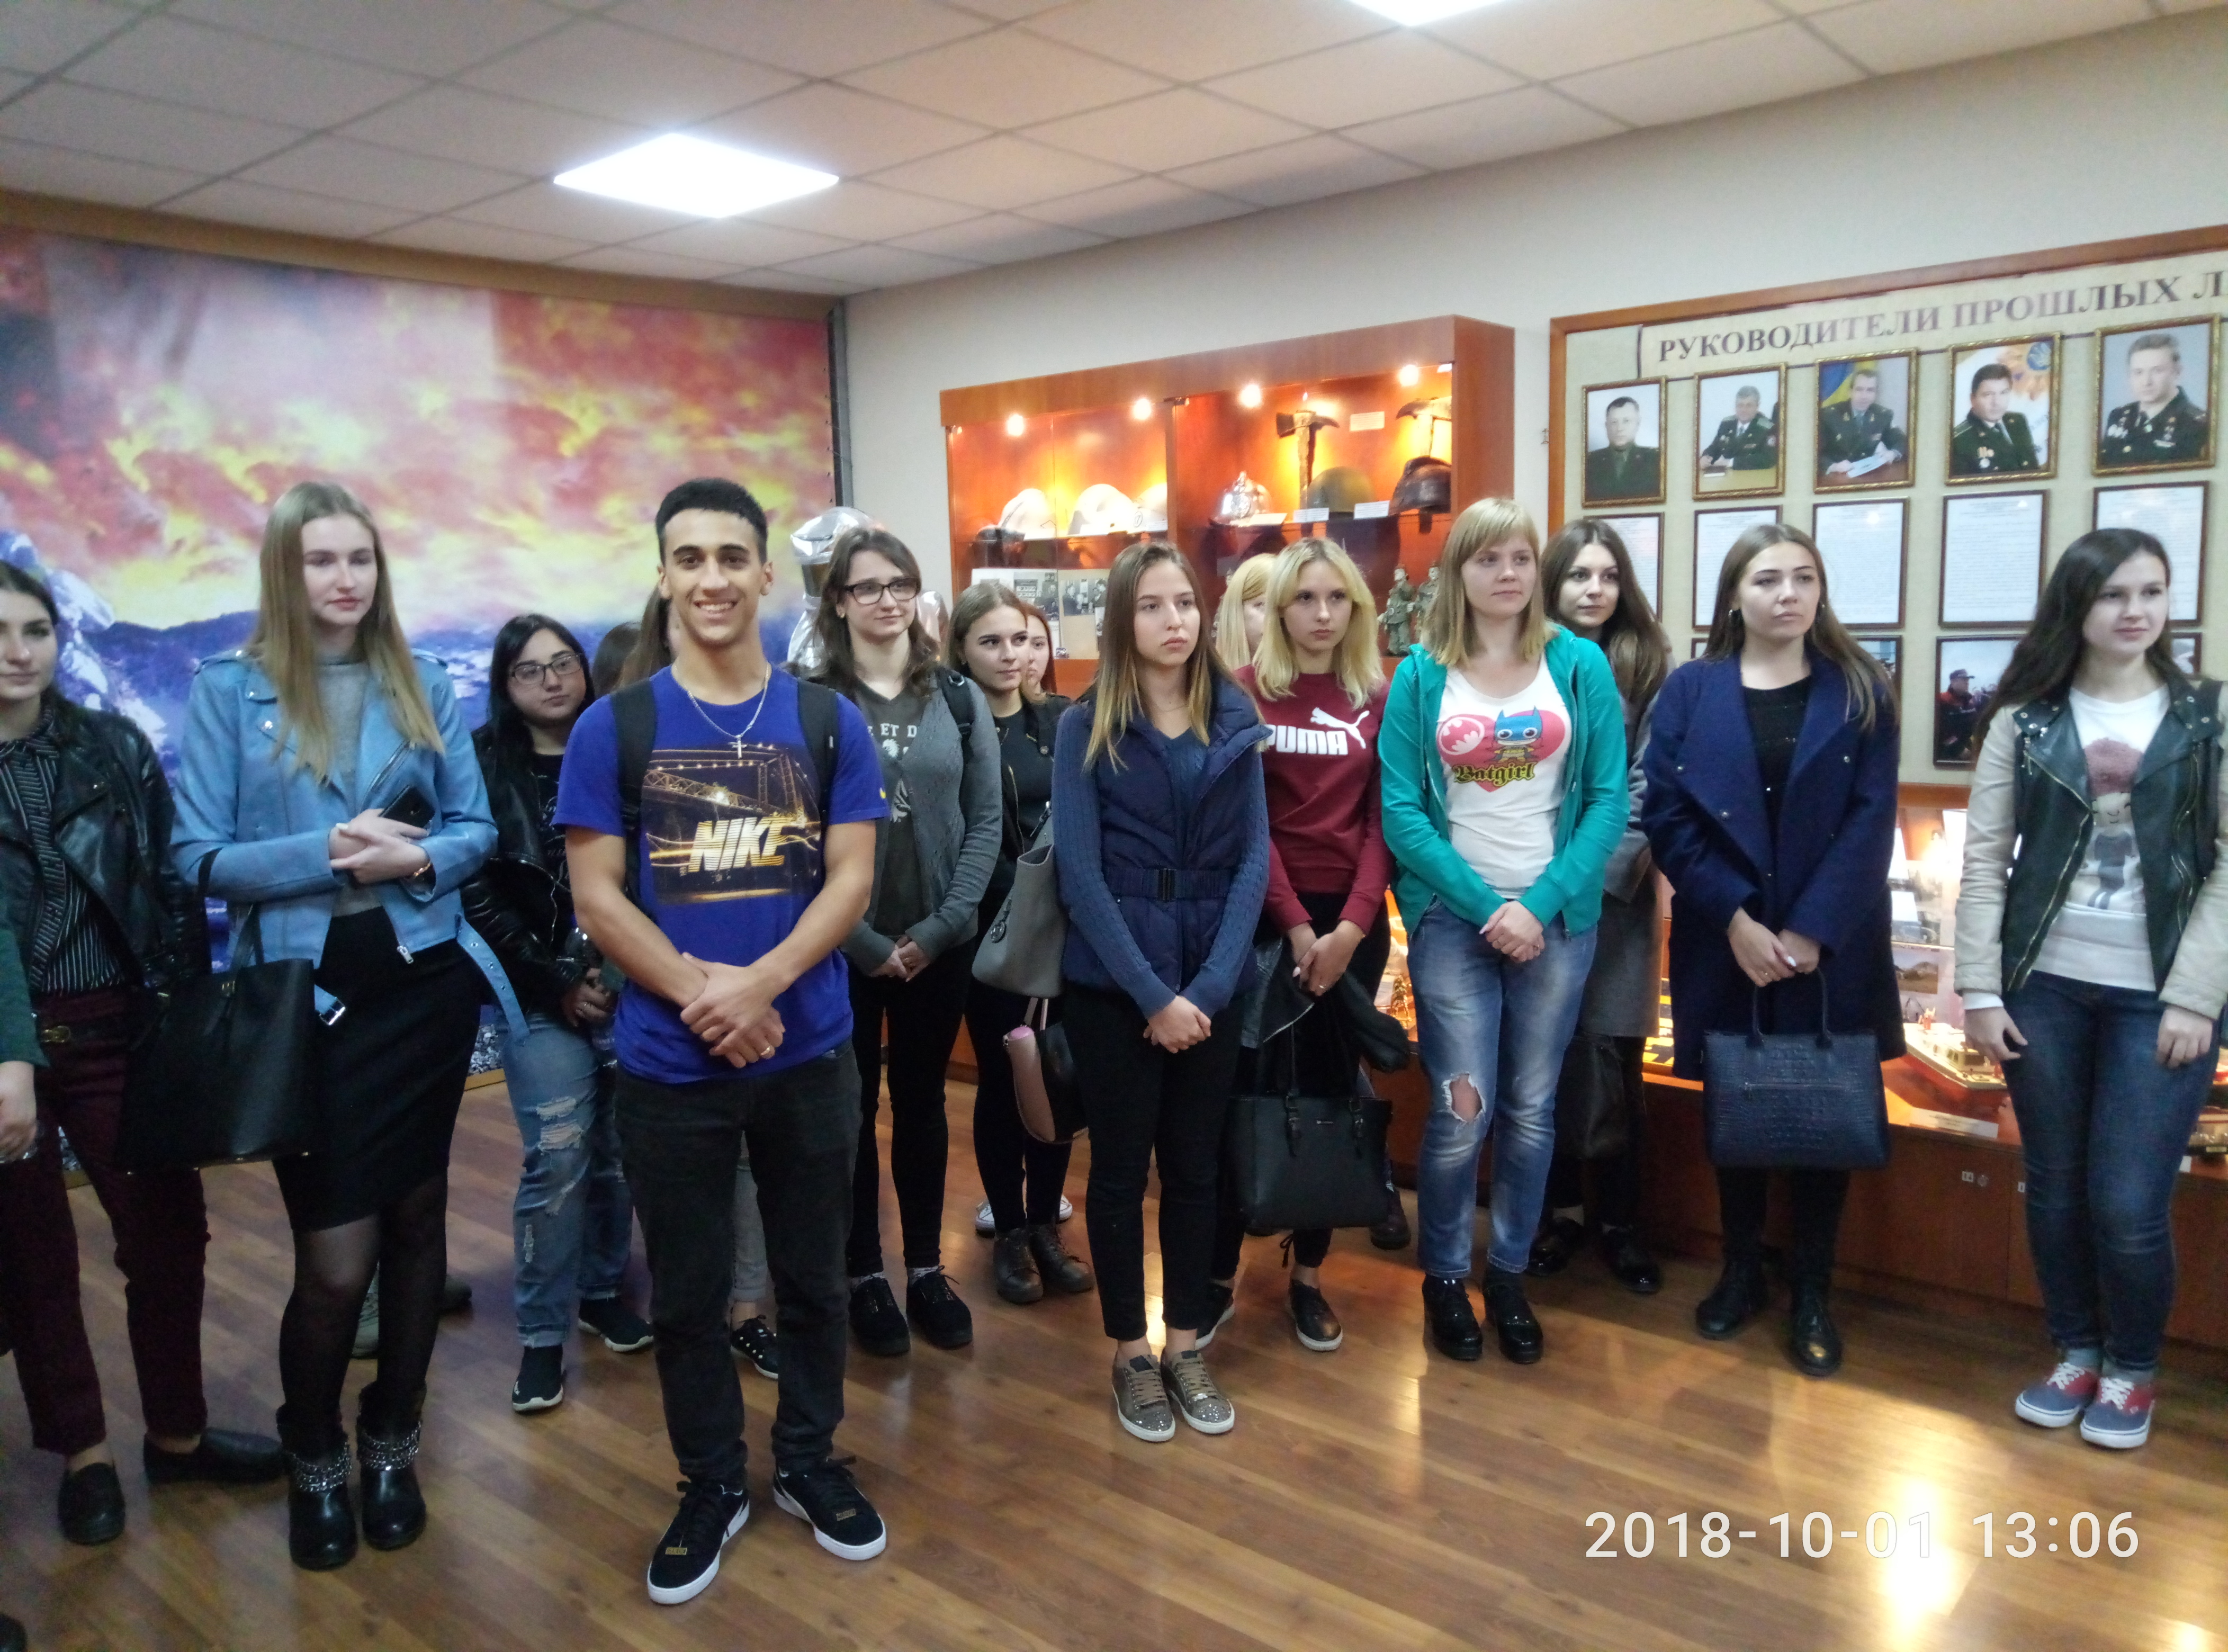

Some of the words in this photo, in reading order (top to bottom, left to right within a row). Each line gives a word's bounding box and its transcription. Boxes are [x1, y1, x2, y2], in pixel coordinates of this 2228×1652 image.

[1659, 306, 1940, 362] РУКОВОДИТЕЛИ
[1952, 276, 2181, 328] ПРОШЛЫХ
[880, 723, 900, 738] ET
[1452, 762, 1536, 786] Batgirl
[688, 816, 791, 873] NIKE
